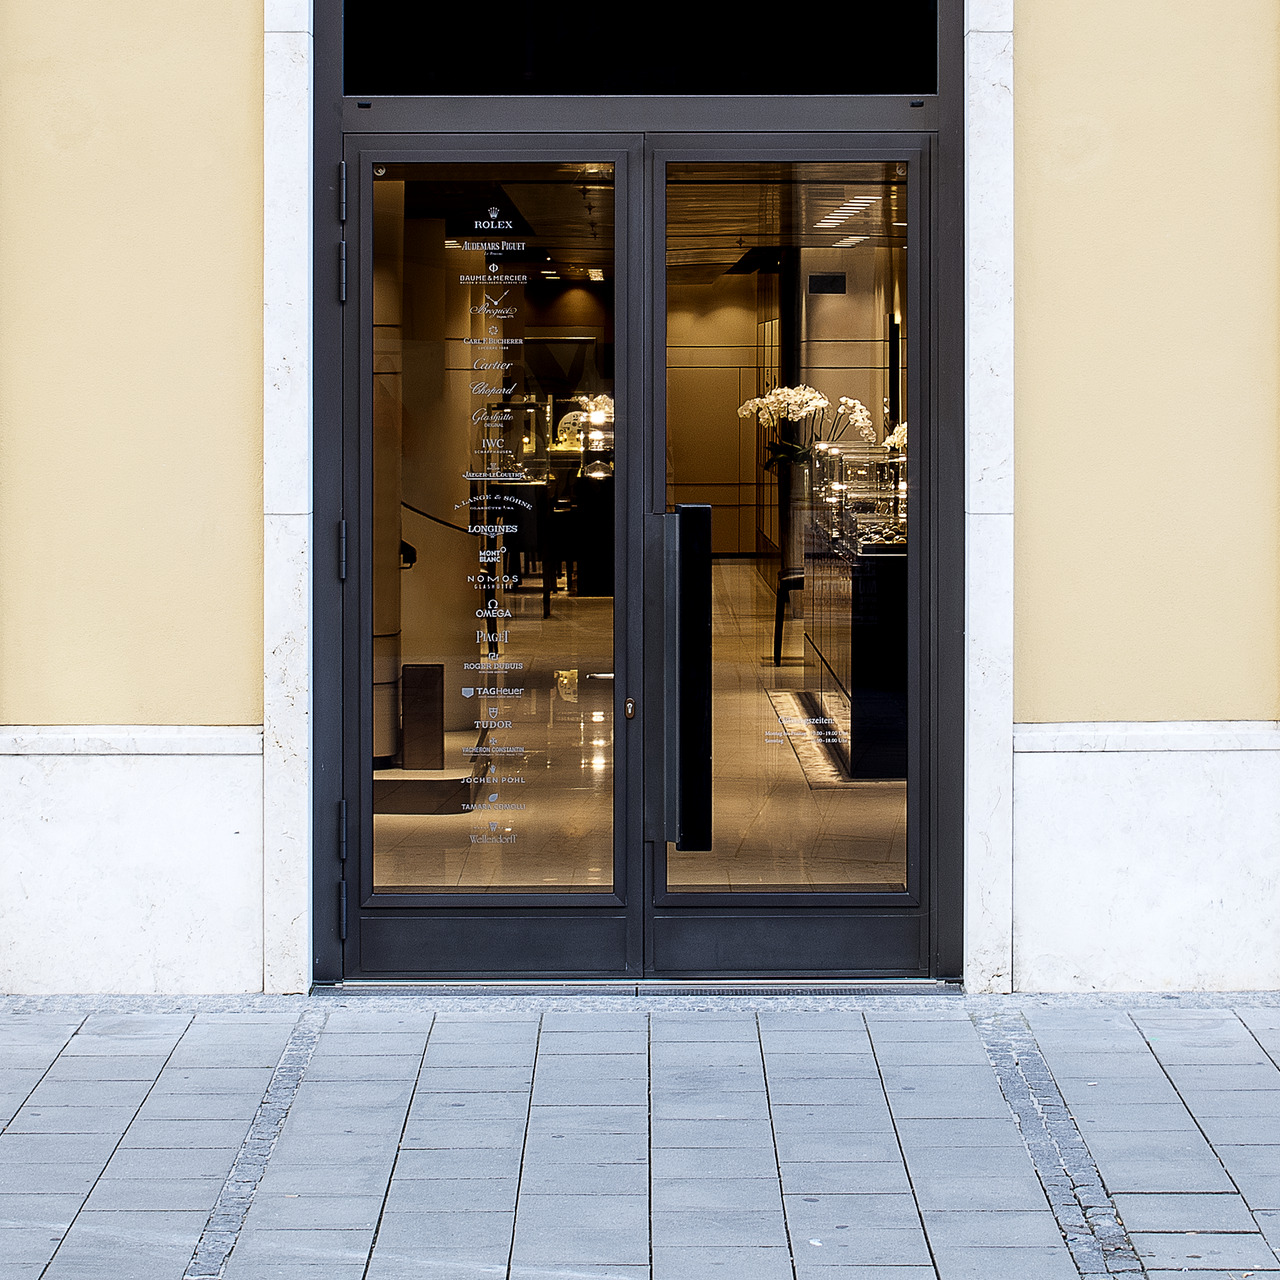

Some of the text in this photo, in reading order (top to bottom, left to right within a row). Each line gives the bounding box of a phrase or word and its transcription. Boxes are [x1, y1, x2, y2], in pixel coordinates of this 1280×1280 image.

[474, 220, 513, 229] ROLEX
[461, 240, 526, 251] AUDEMARS PIGUET
[488, 337, 524, 345] BUCHERER
[473, 357, 514, 370] Cartier
[469, 381, 517, 397] Chopard
[482, 438, 505, 449] IWC
[468, 525, 518, 533] LONGINES
[467, 574, 519, 583] NOMOS
[475, 609, 512, 618] OMEGA
[475, 630, 511, 644] PIAGET
[463, 662, 523, 670] ROGER DUBUIS
[473, 720, 513, 729] TUDOR
[461, 776, 498, 784] JOCHEN
